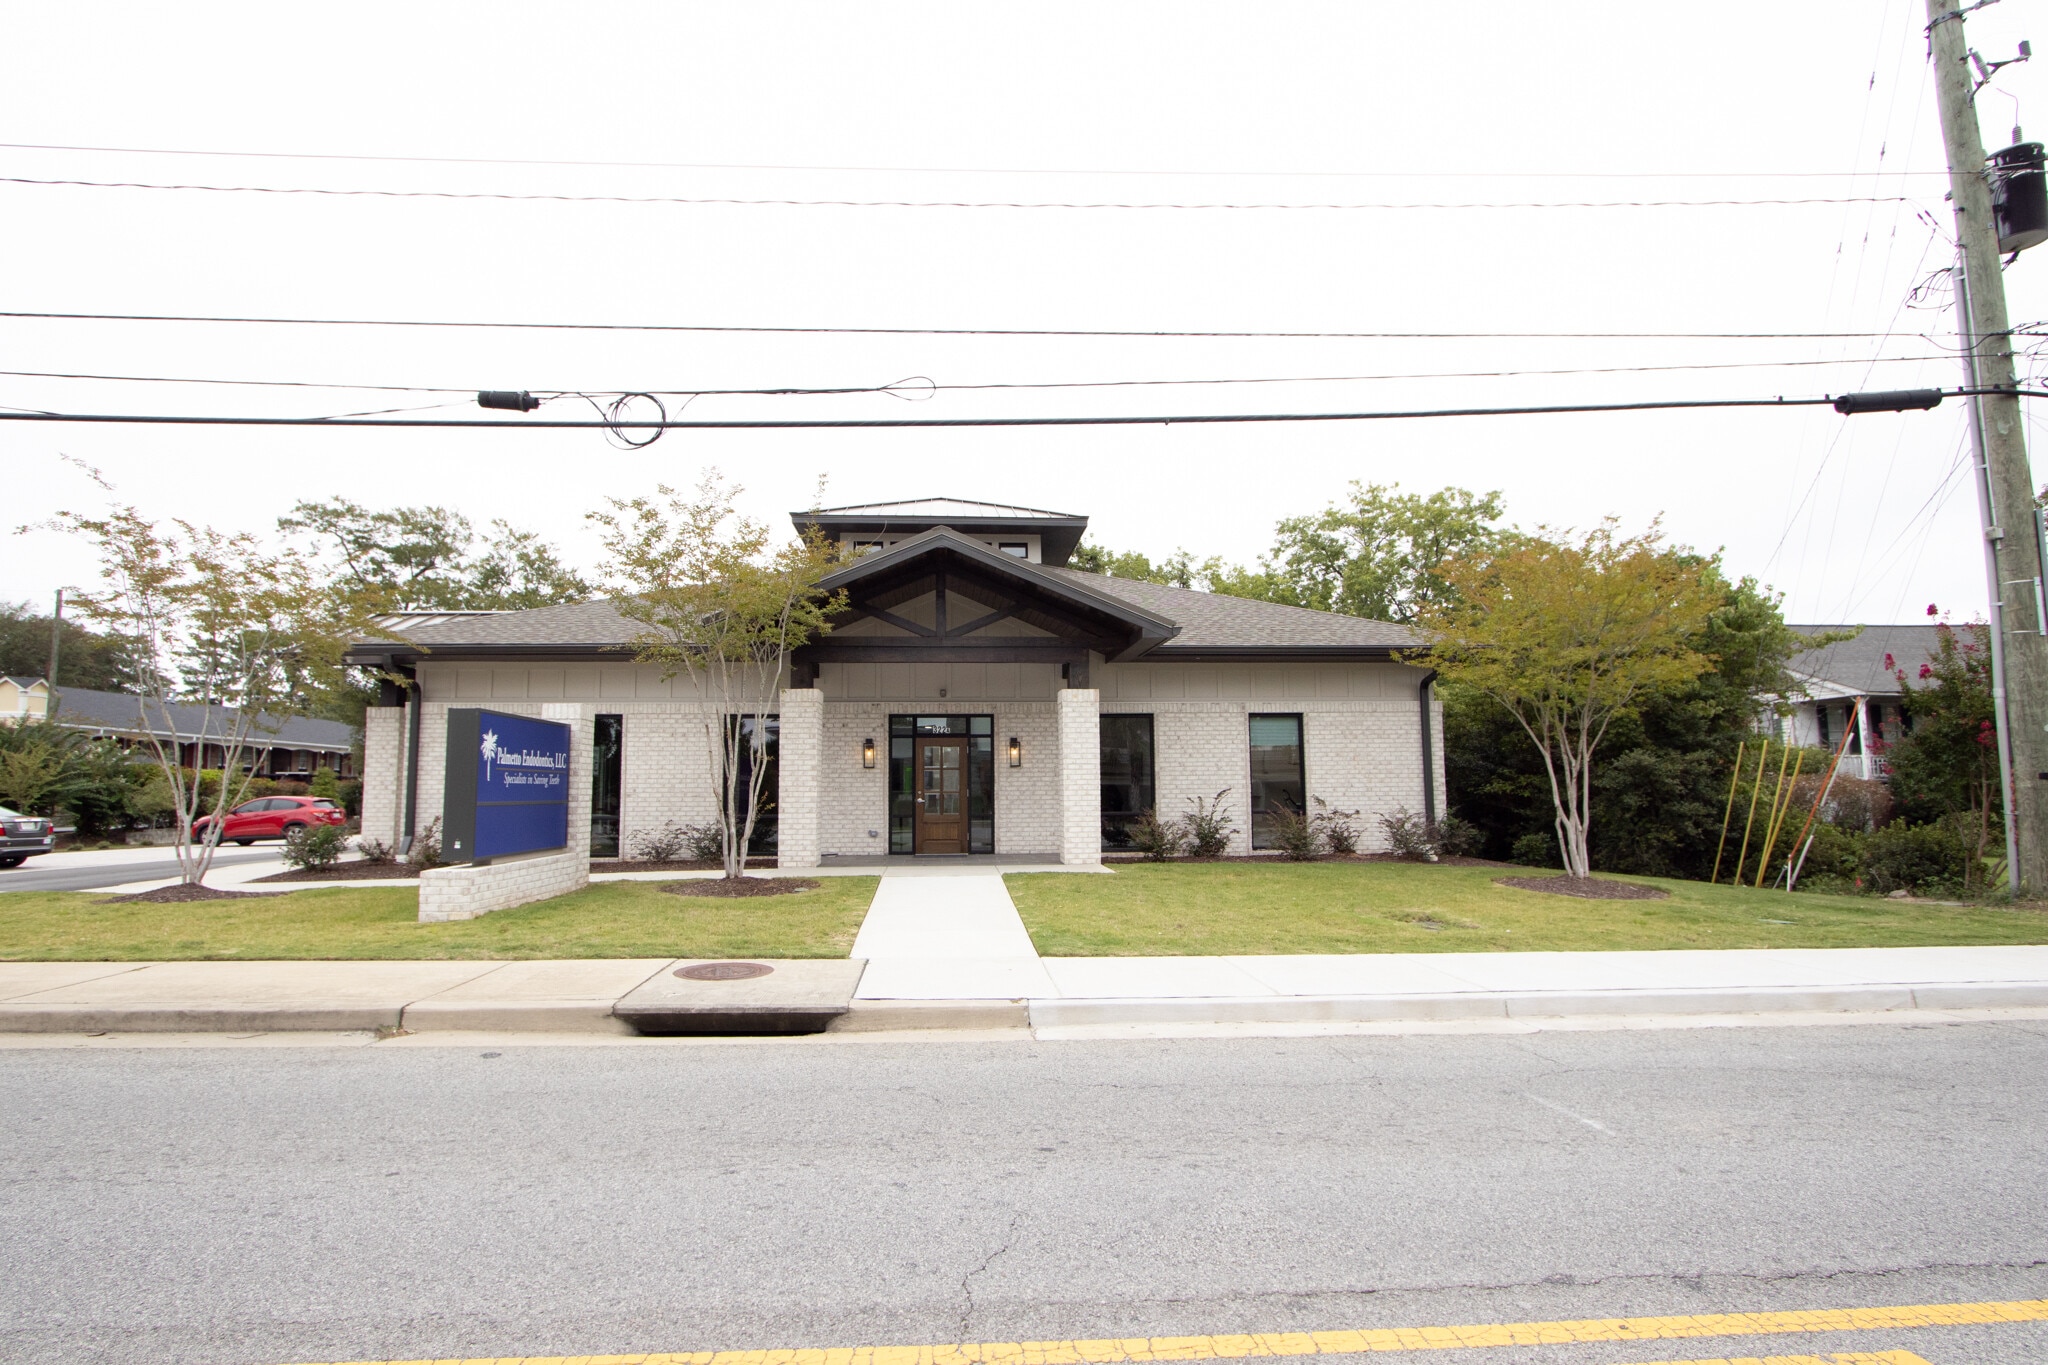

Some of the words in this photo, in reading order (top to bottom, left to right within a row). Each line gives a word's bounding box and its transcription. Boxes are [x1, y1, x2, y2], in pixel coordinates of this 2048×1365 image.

[497, 747, 522, 766] Palmetto
[522, 749, 555, 770] Endodontics,
[555, 752, 567, 769] LLC
[503, 772, 527, 788] Specialists
[527, 773, 533, 785] in
[533, 773, 549, 789] Saving
[549, 773, 560, 785] Teeth
